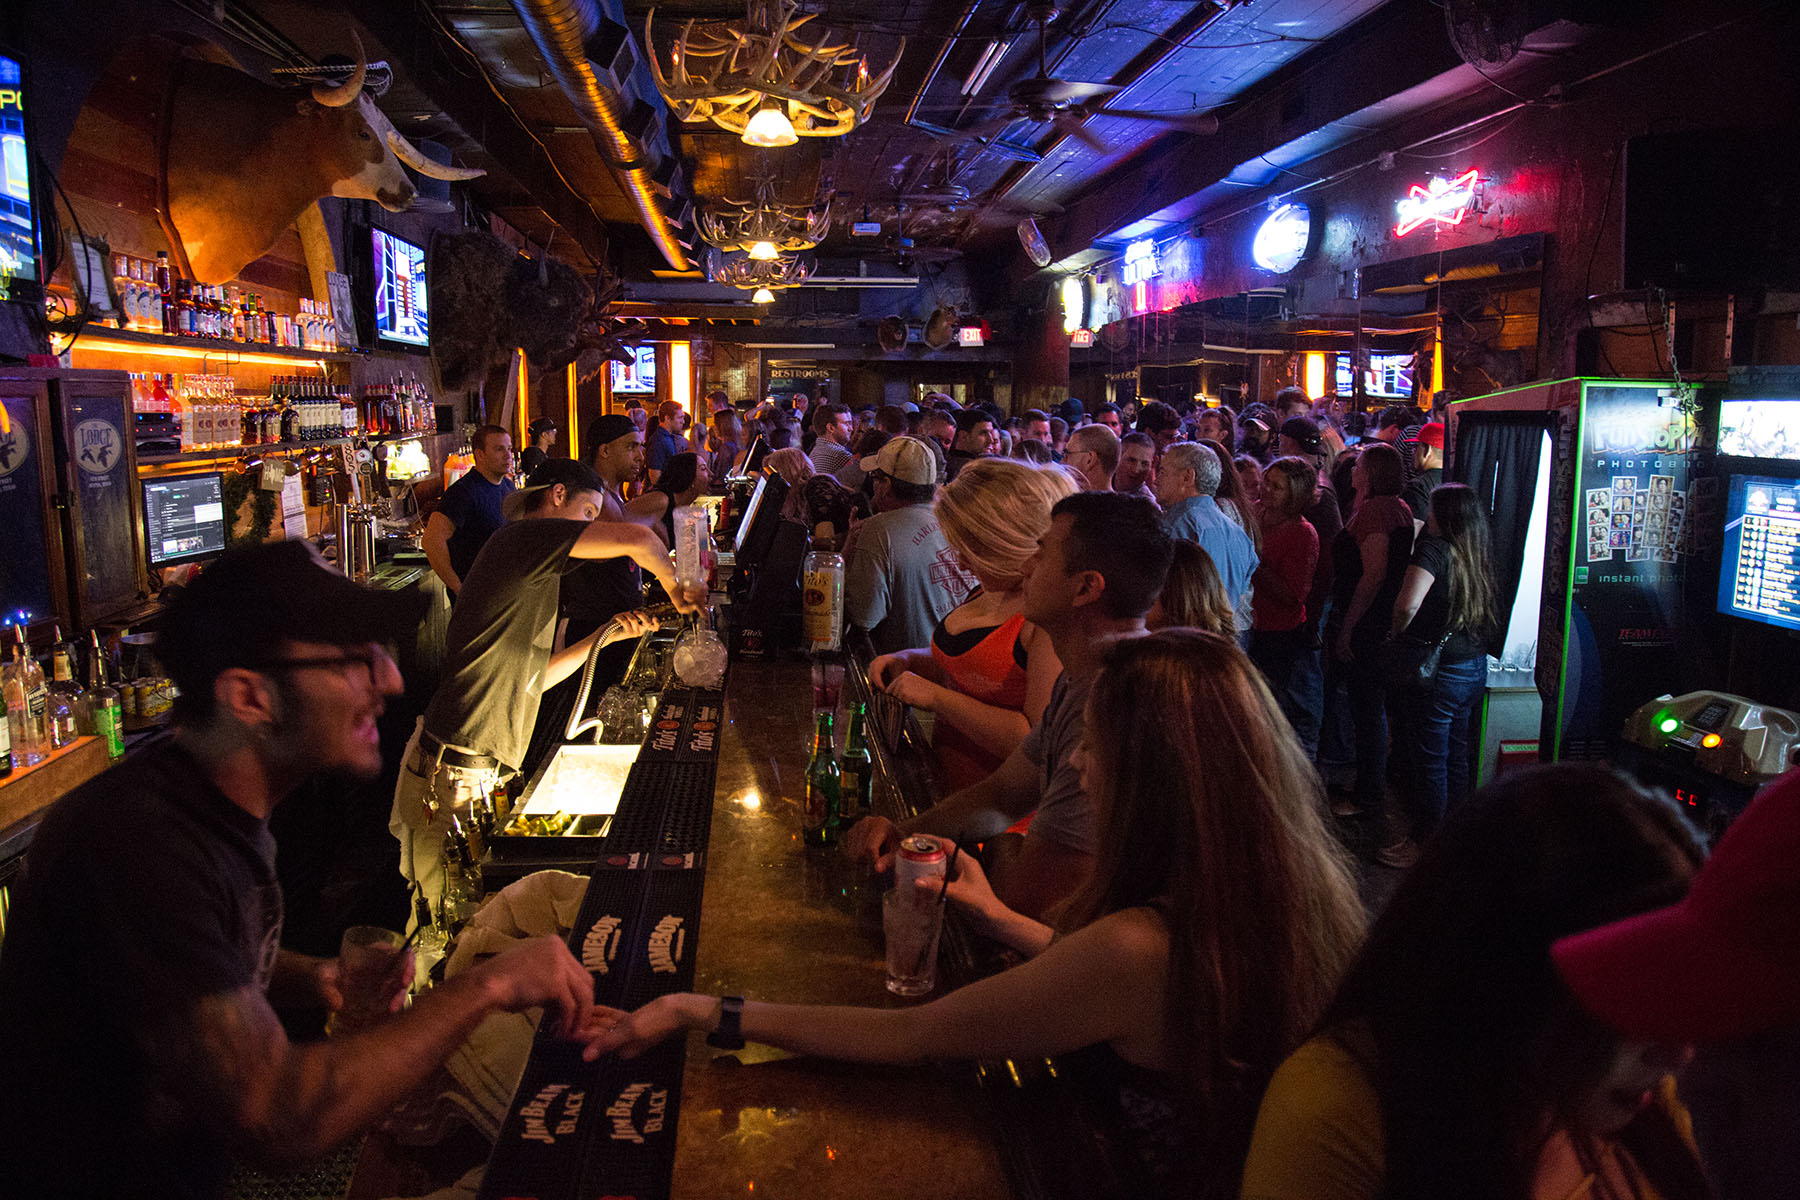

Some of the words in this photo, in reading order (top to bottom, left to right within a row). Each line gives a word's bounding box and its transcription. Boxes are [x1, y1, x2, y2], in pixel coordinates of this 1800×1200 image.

[963, 329, 981, 341] EXIT
[771, 369, 830, 378] RESTROOMS
[80, 428, 112, 449] LODGE
[1598, 573, 1643, 583] instant
[651, 729, 679, 751] Tito's
[689, 731, 715, 752] Tito's
[648, 914, 684, 974] JAMESON
[519, 1084, 573, 1117] BEAM
[555, 1091, 585, 1135] BLACK
[606, 1083, 654, 1117] BEAM
[643, 1088, 669, 1135] BLACK
[521, 1115, 556, 1144] JIM
[610, 1116, 645, 1144] JIM
